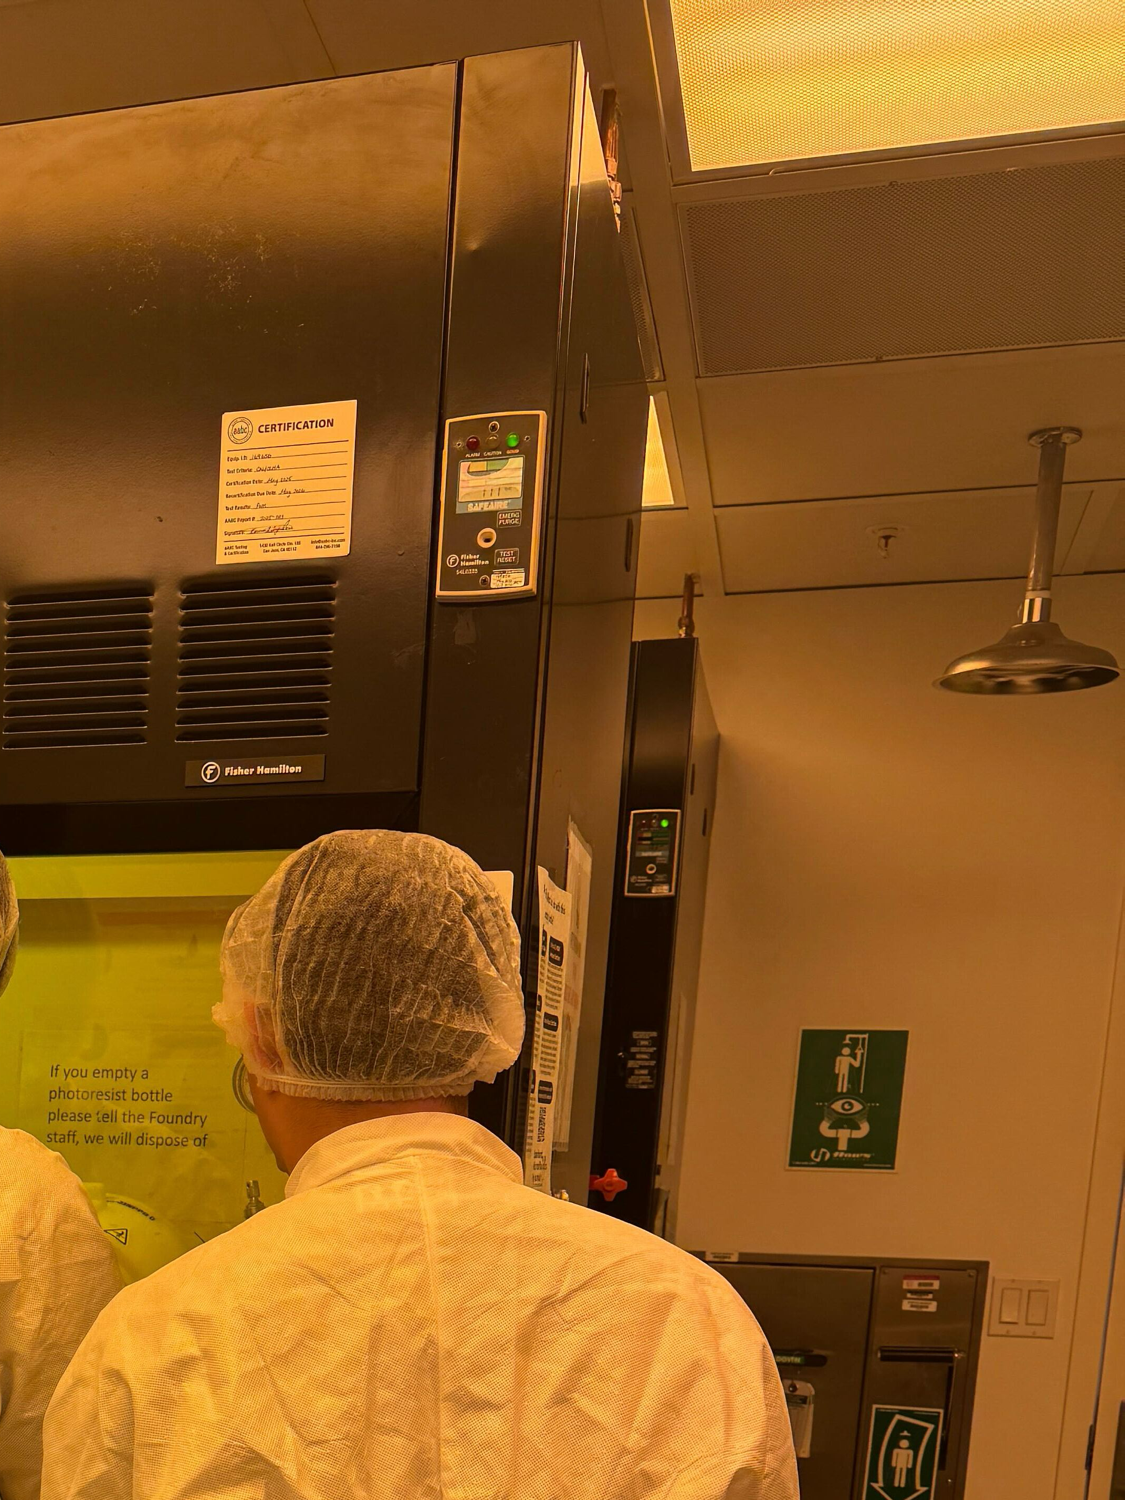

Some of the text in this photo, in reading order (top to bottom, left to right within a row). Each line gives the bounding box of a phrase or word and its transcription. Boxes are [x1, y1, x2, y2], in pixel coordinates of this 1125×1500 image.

[258, 418, 334, 433] CERTIFICATION
[467, 501, 509, 512] SAFEAIRE
[498, 518, 520, 526] PURGE
[225, 766, 254, 777] Fisher
[256, 764, 302, 775] Hamilton
[49, 1064, 149, 1082] If you empty a
[48, 1087, 173, 1103] photoresist bottle
[47, 1108, 208, 1128] please tell the Foundry
[46, 1130, 209, 1149] staff, we will dispose of
